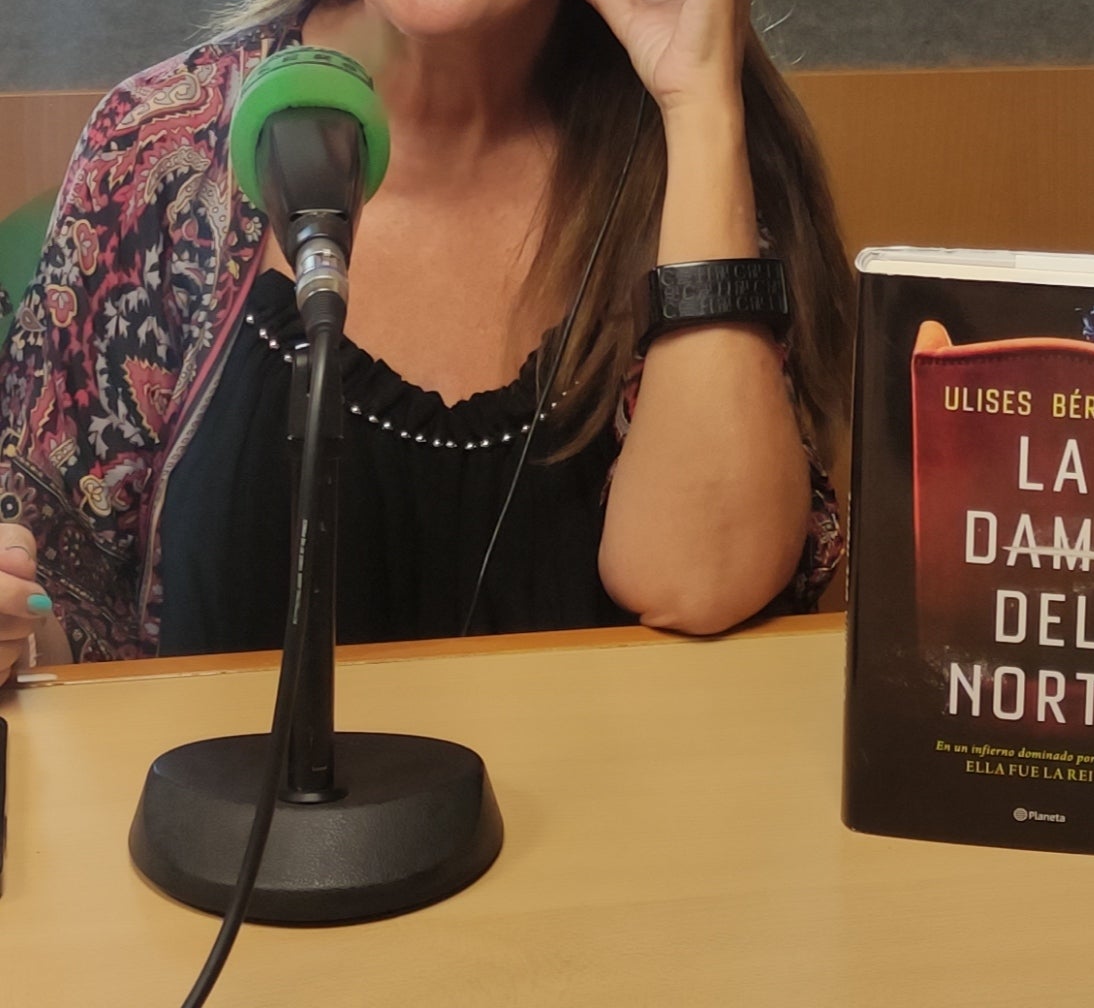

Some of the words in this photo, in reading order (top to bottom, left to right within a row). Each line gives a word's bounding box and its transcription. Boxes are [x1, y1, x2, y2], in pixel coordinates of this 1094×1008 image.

[944, 385, 1032, 416] ULISES
[1018, 435, 1088, 494] LA
[935, 740, 951, 752] En
[954, 745, 968, 754] un
[971, 744, 1015, 758] infierno
[1018, 747, 1074, 762] dominado
[965, 759, 1005, 776] ELLA
[1008, 763, 1041, 778] FUE
[1042, 766, 1064, 780] LA
[1028, 810, 1066, 823] Planeta
